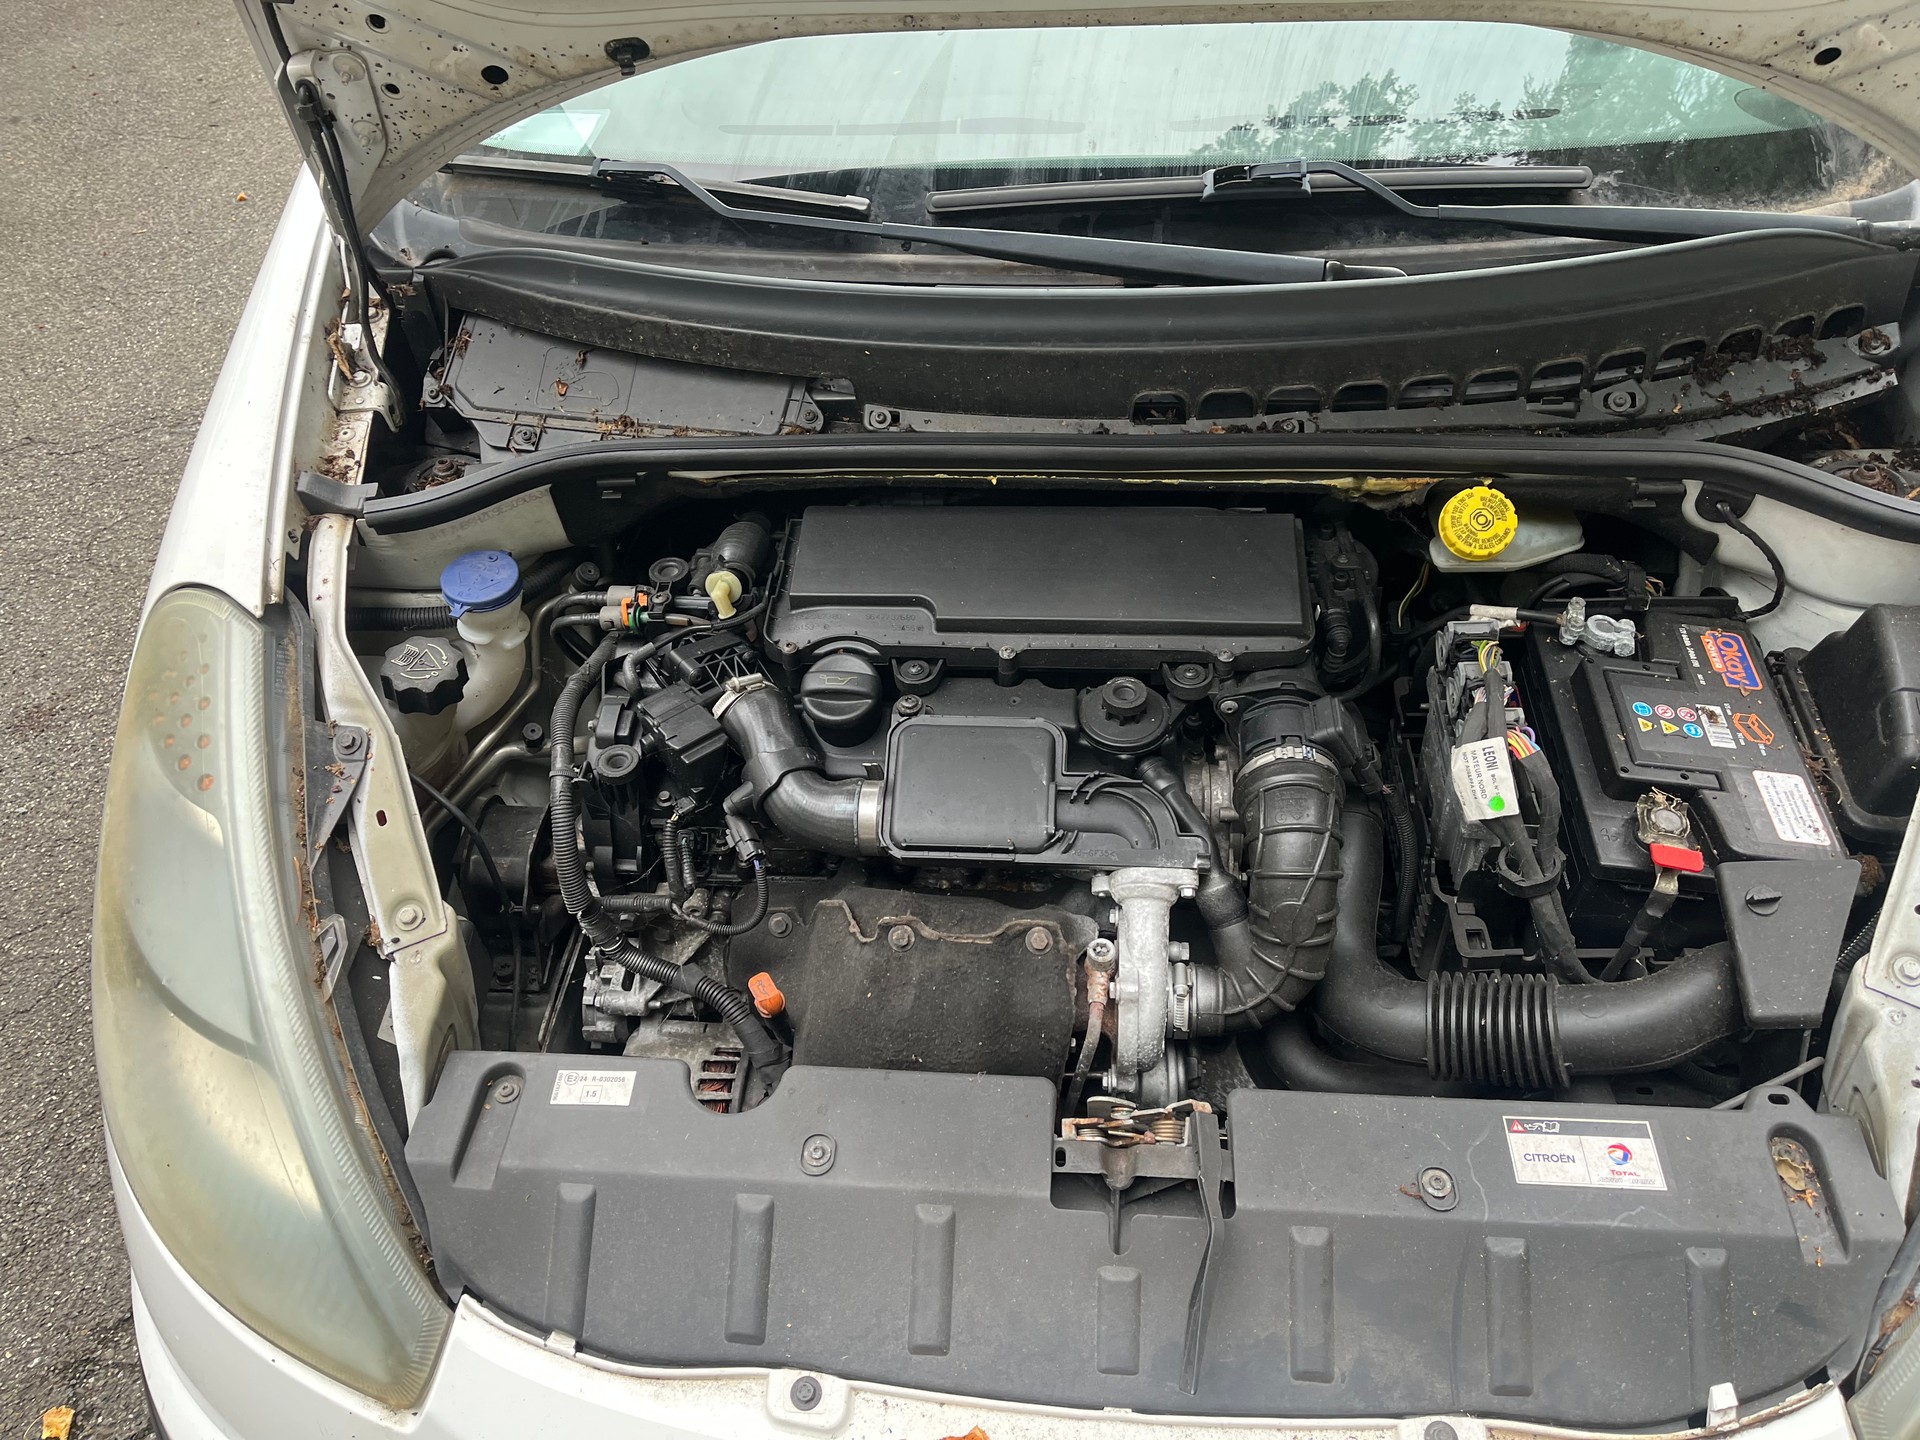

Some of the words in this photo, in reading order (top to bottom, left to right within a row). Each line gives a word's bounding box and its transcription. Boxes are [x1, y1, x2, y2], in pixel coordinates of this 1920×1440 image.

[1703, 638, 1723, 669] POWER
[1716, 637, 1751, 686] Okay
[1482, 745, 1499, 771] LEONI
[1477, 779, 1488, 799] NORD
[585, 1090, 598, 1098] 1.5
[1523, 1152, 1576, 1164] CITROËN
